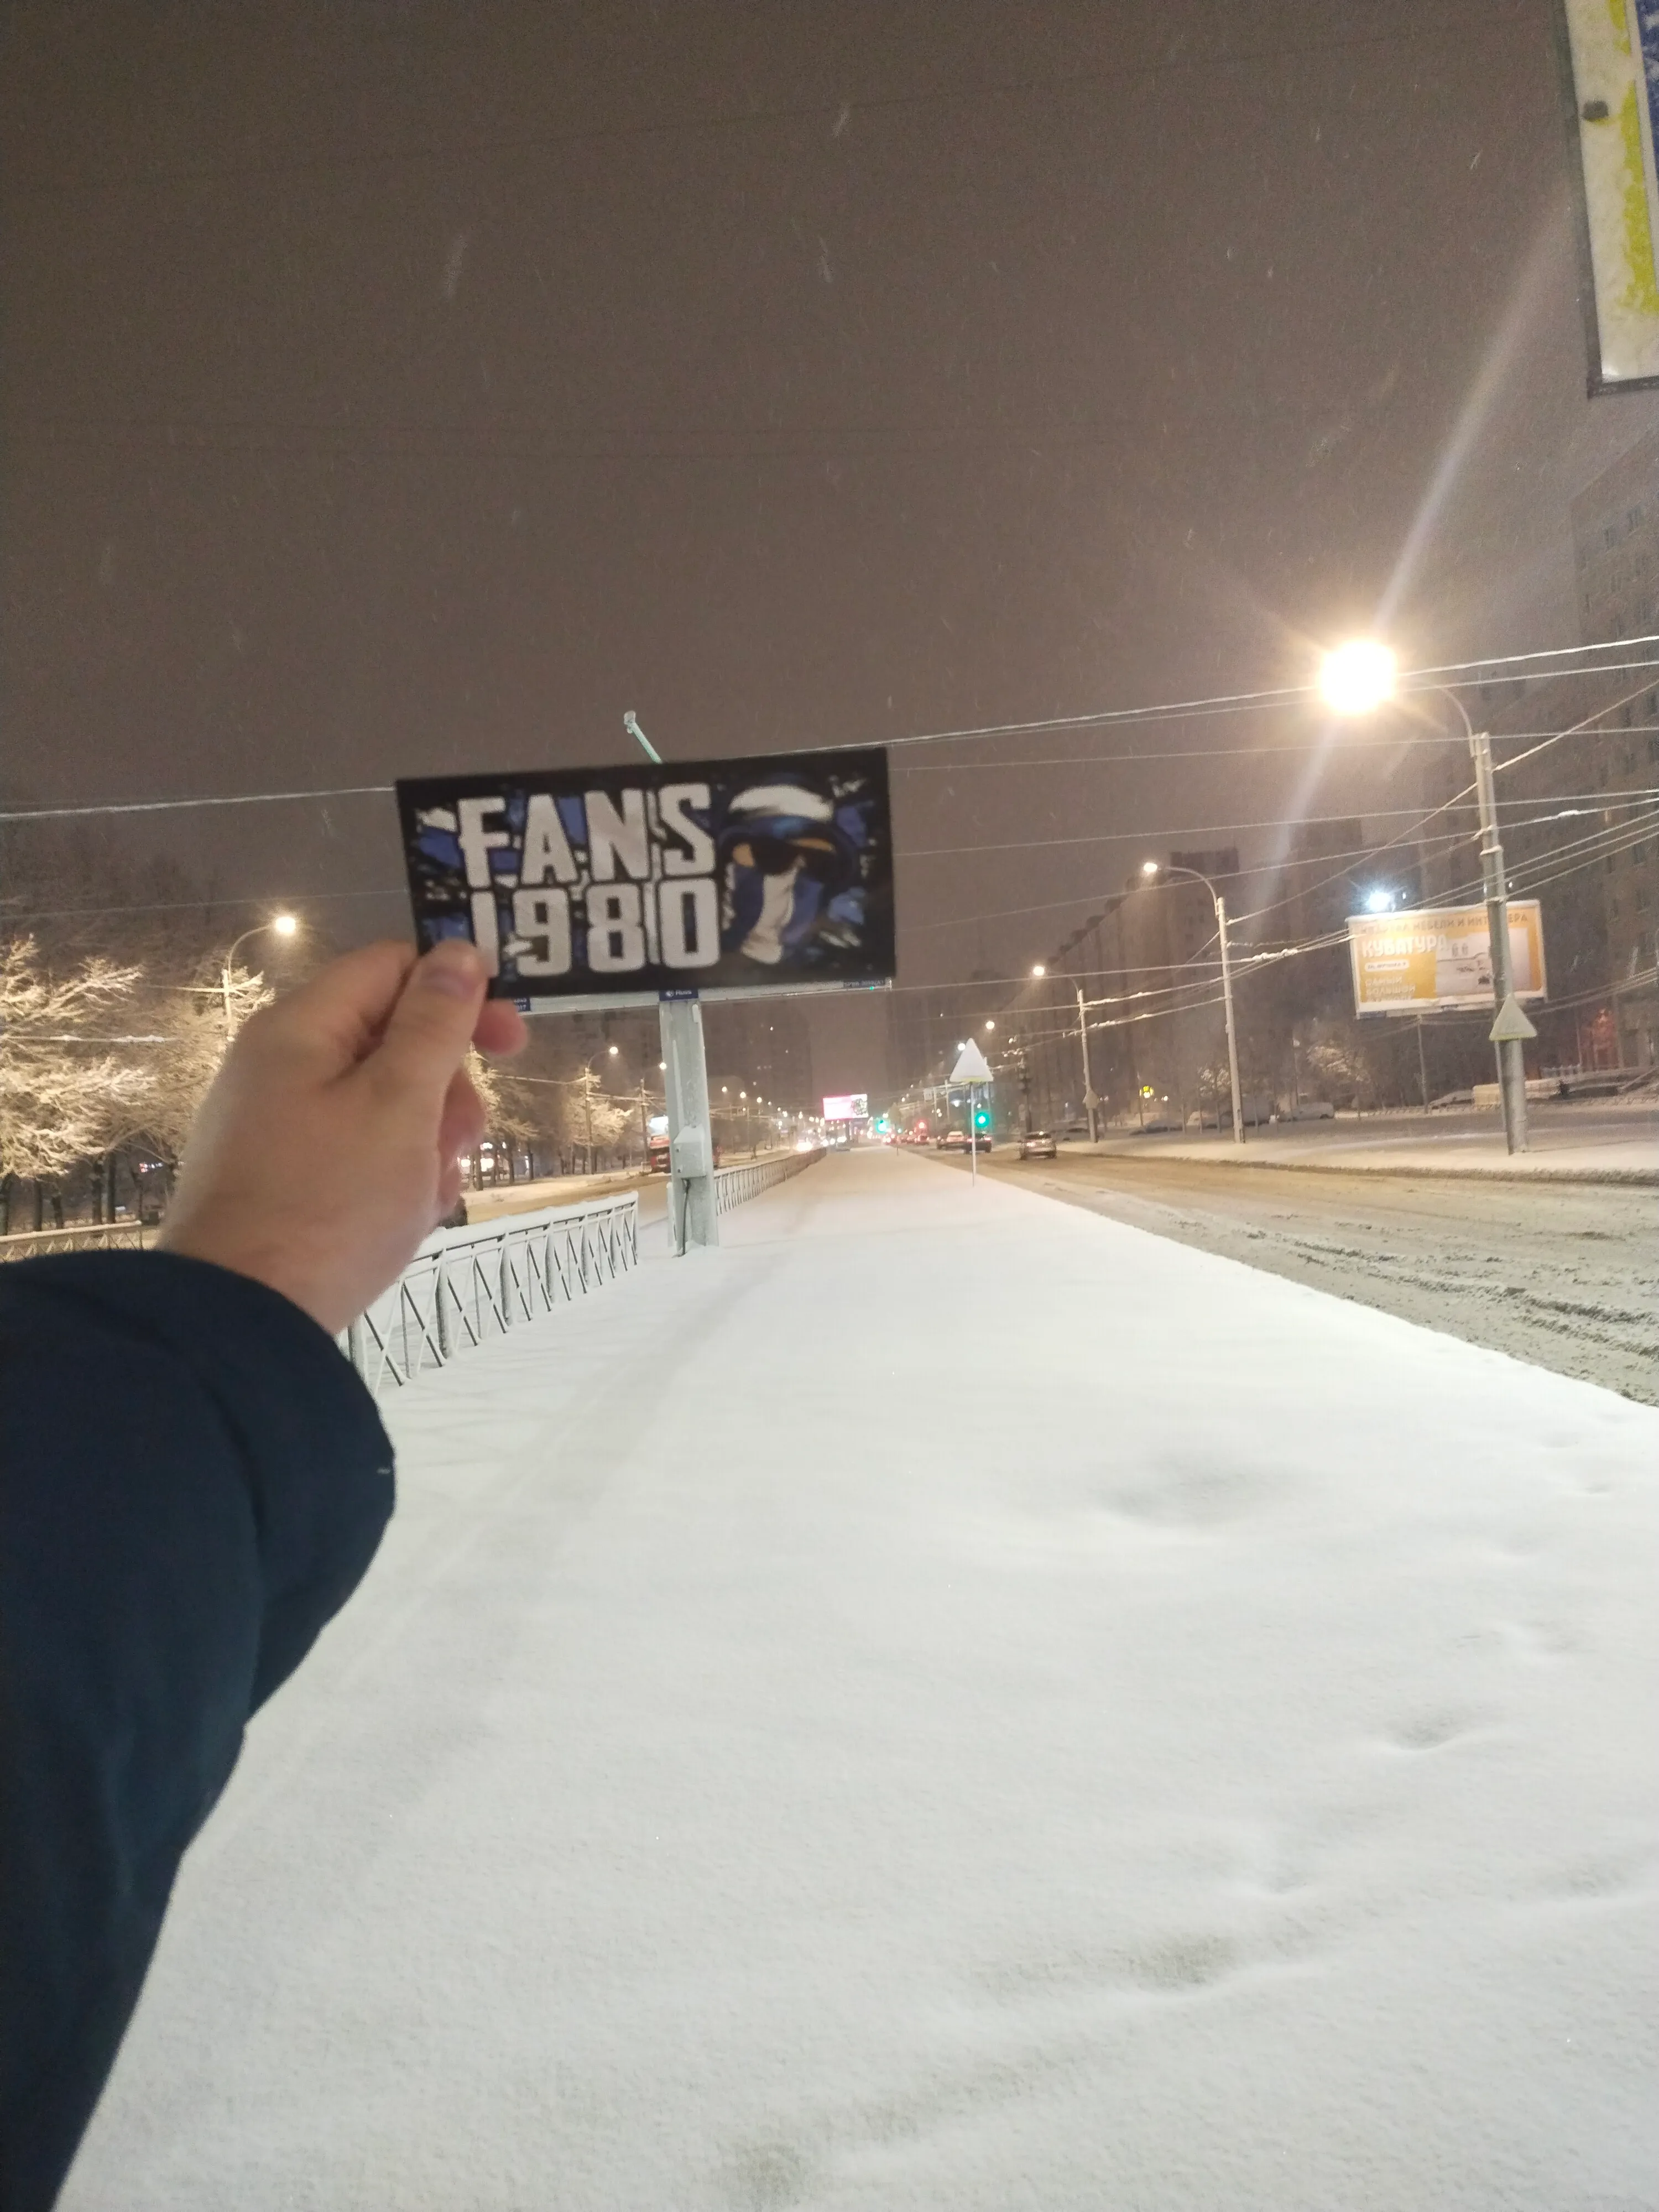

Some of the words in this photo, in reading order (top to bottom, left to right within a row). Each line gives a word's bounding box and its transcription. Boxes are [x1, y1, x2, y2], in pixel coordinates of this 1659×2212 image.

[457, 782, 715, 888] FANS
[469, 878, 721, 978] 1980
[1361, 934, 1448, 958] КУБАТУРА
